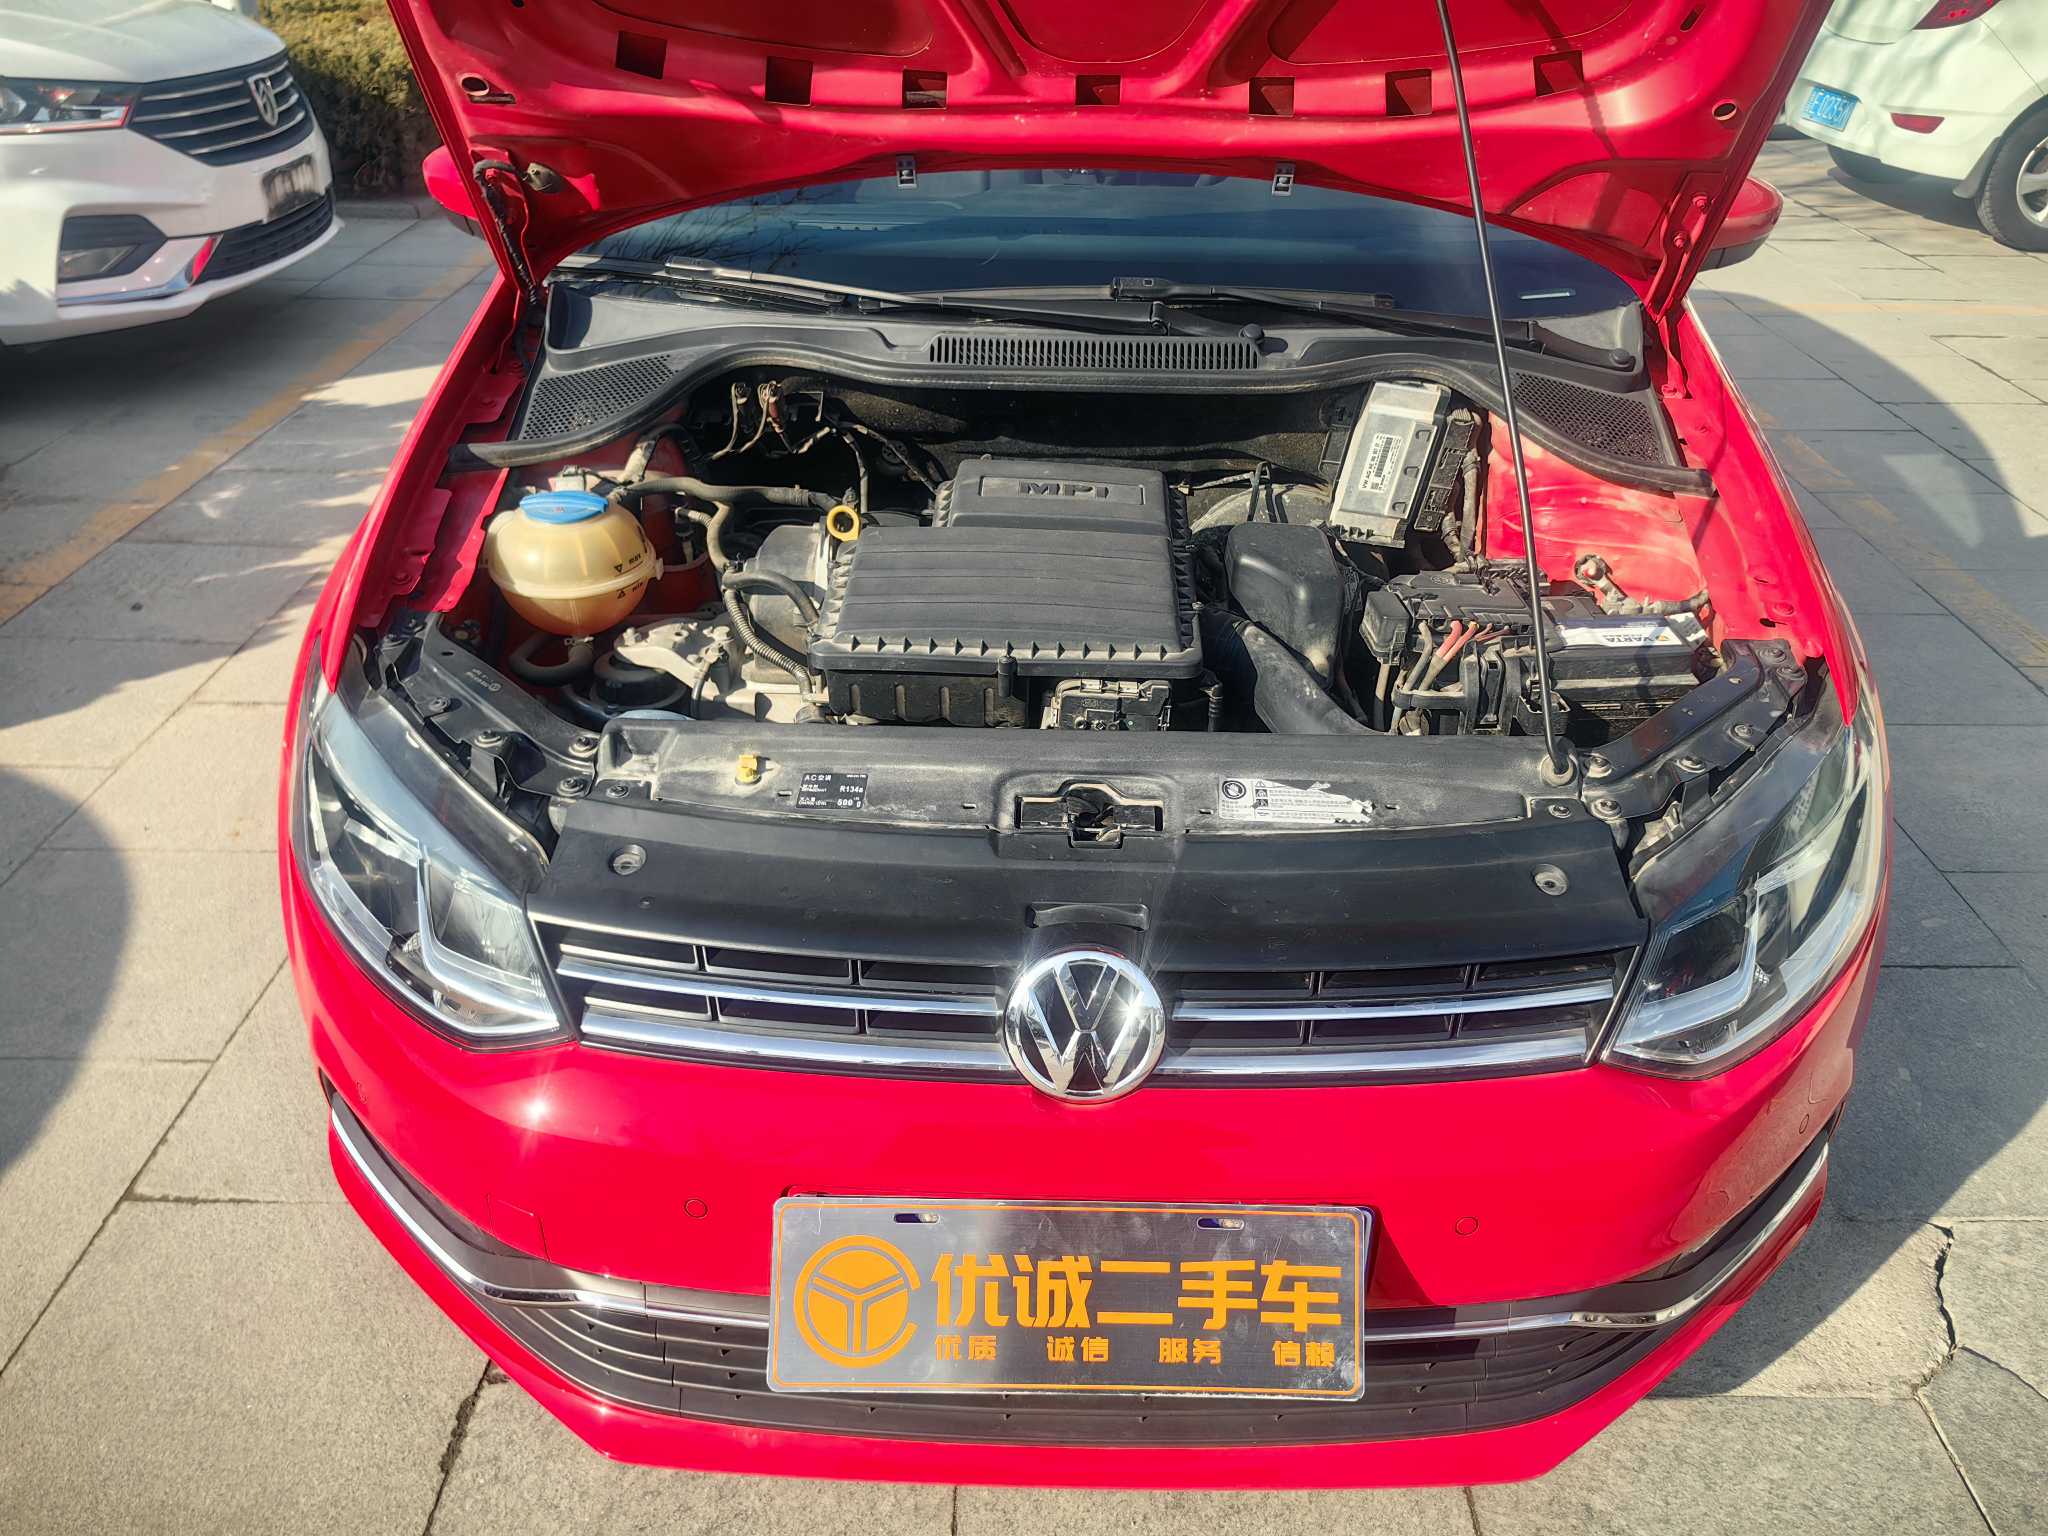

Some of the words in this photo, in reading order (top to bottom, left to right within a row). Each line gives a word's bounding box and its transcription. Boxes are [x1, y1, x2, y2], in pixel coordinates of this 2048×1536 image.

[1020, 482, 1109, 499] MPI
[931, 1253, 1343, 1333] 优诚二手车
[935, 1335, 998, 1361] 优质
[1046, 1335, 1109, 1363] 诚信
[1158, 1337, 1222, 1365] 服务
[1271, 1340, 1337, 1370] 信赖
